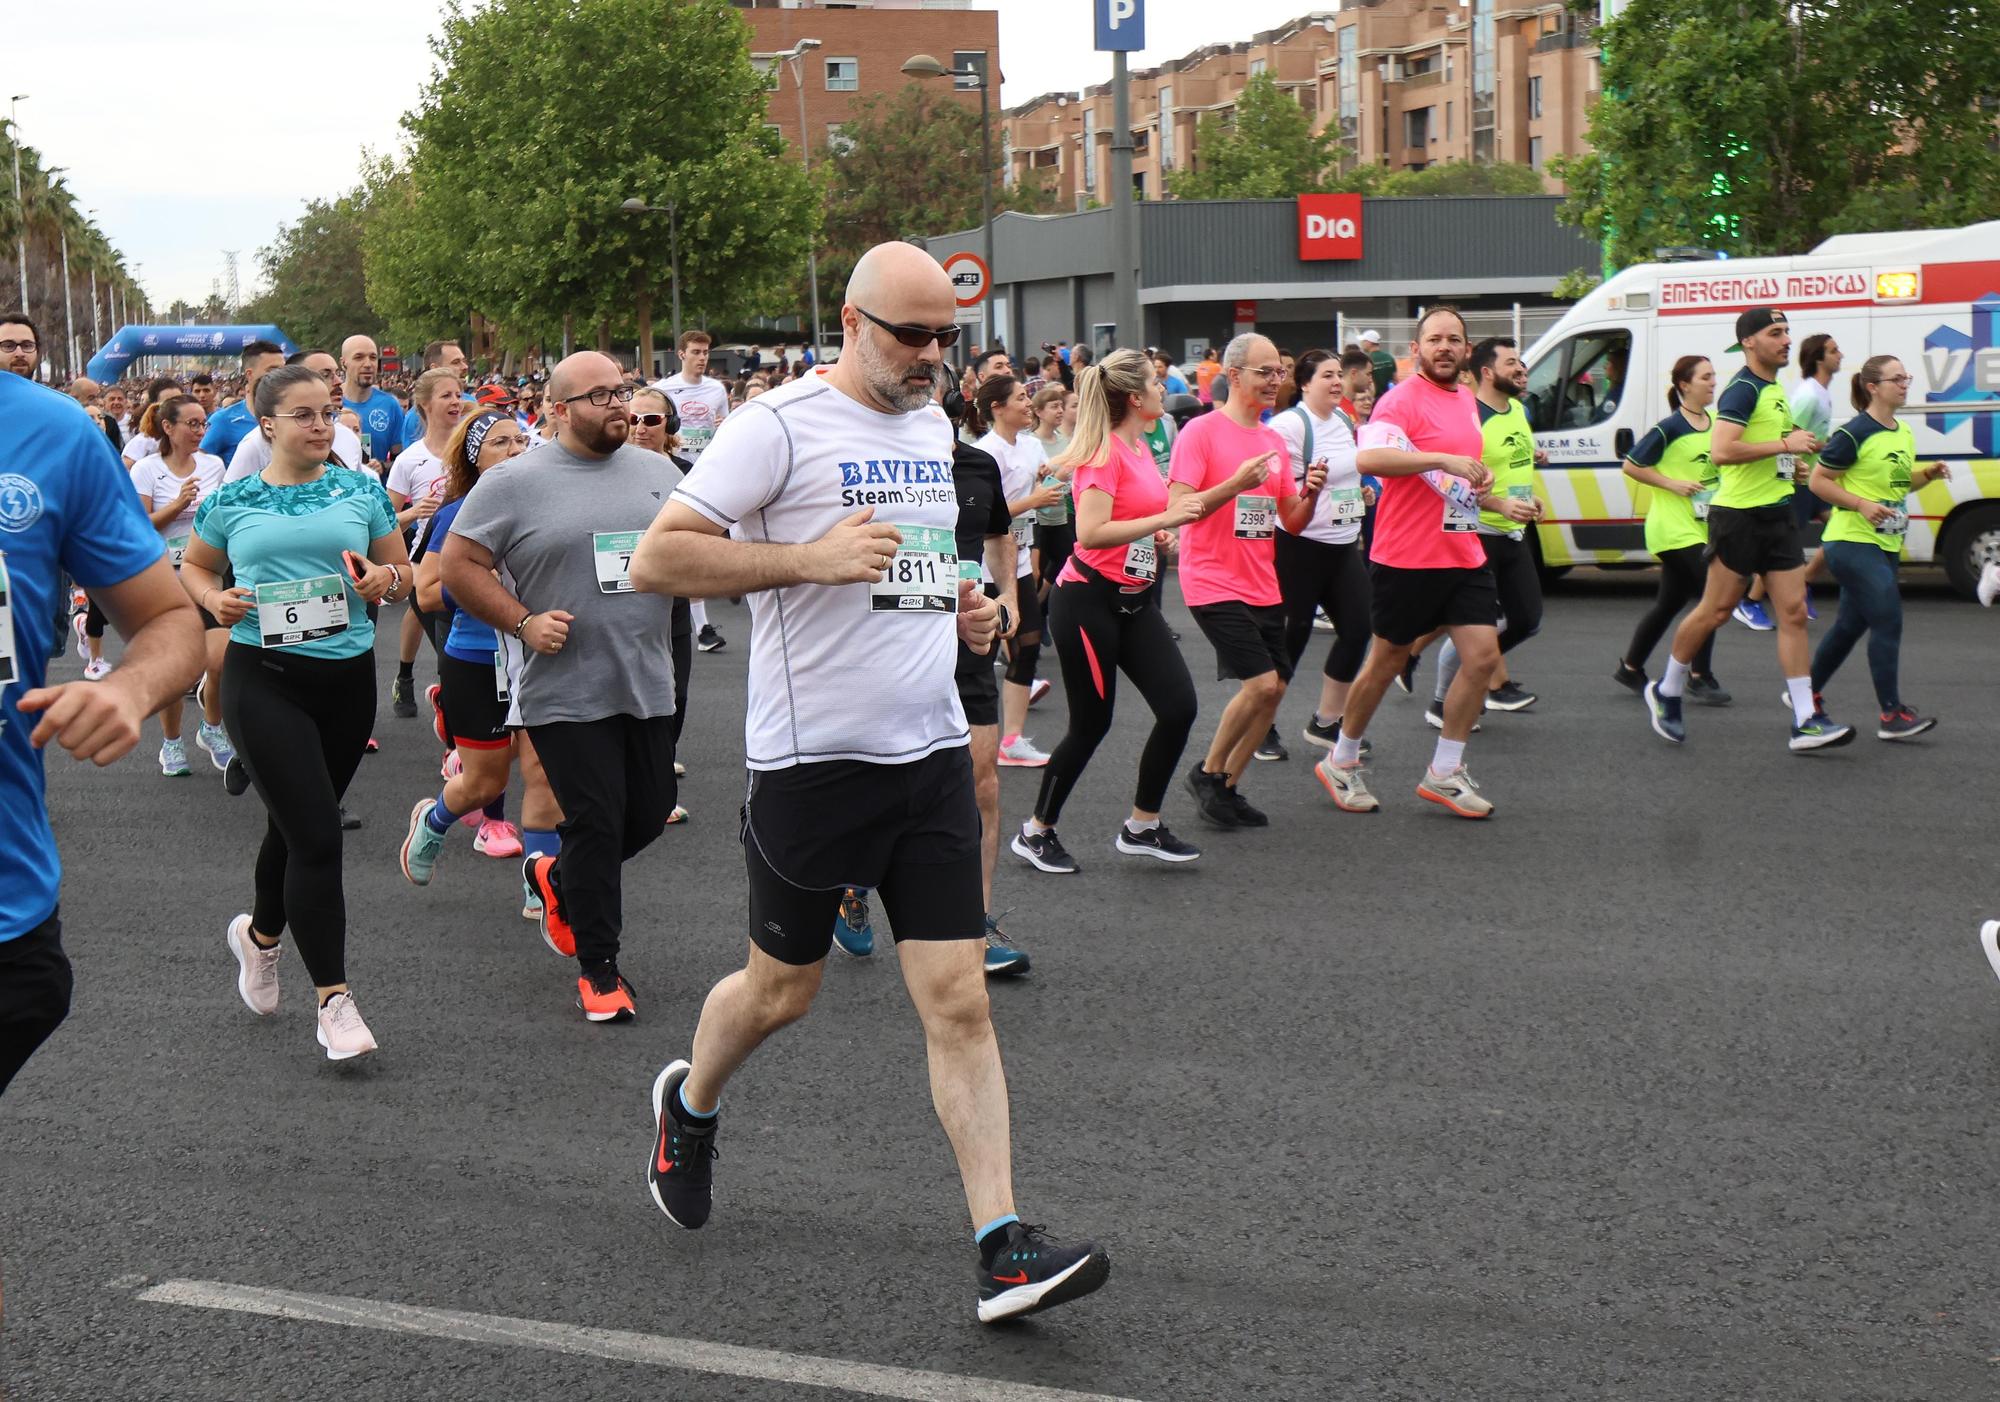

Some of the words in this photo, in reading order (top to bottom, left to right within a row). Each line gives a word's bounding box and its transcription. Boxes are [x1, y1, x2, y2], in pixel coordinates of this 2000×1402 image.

[1109, 0, 1135, 30] P
[468, 415, 499, 464] SEVILLA
[841, 489, 904, 507] Steam
[1338, 502, 1355, 514] 677
[1240, 513, 1266, 526] 2398
[944, 555, 953, 564] 5K
[888, 559, 936, 584] 1811
[327, 594, 339, 603] 5K
[286, 607, 298, 624] 6
